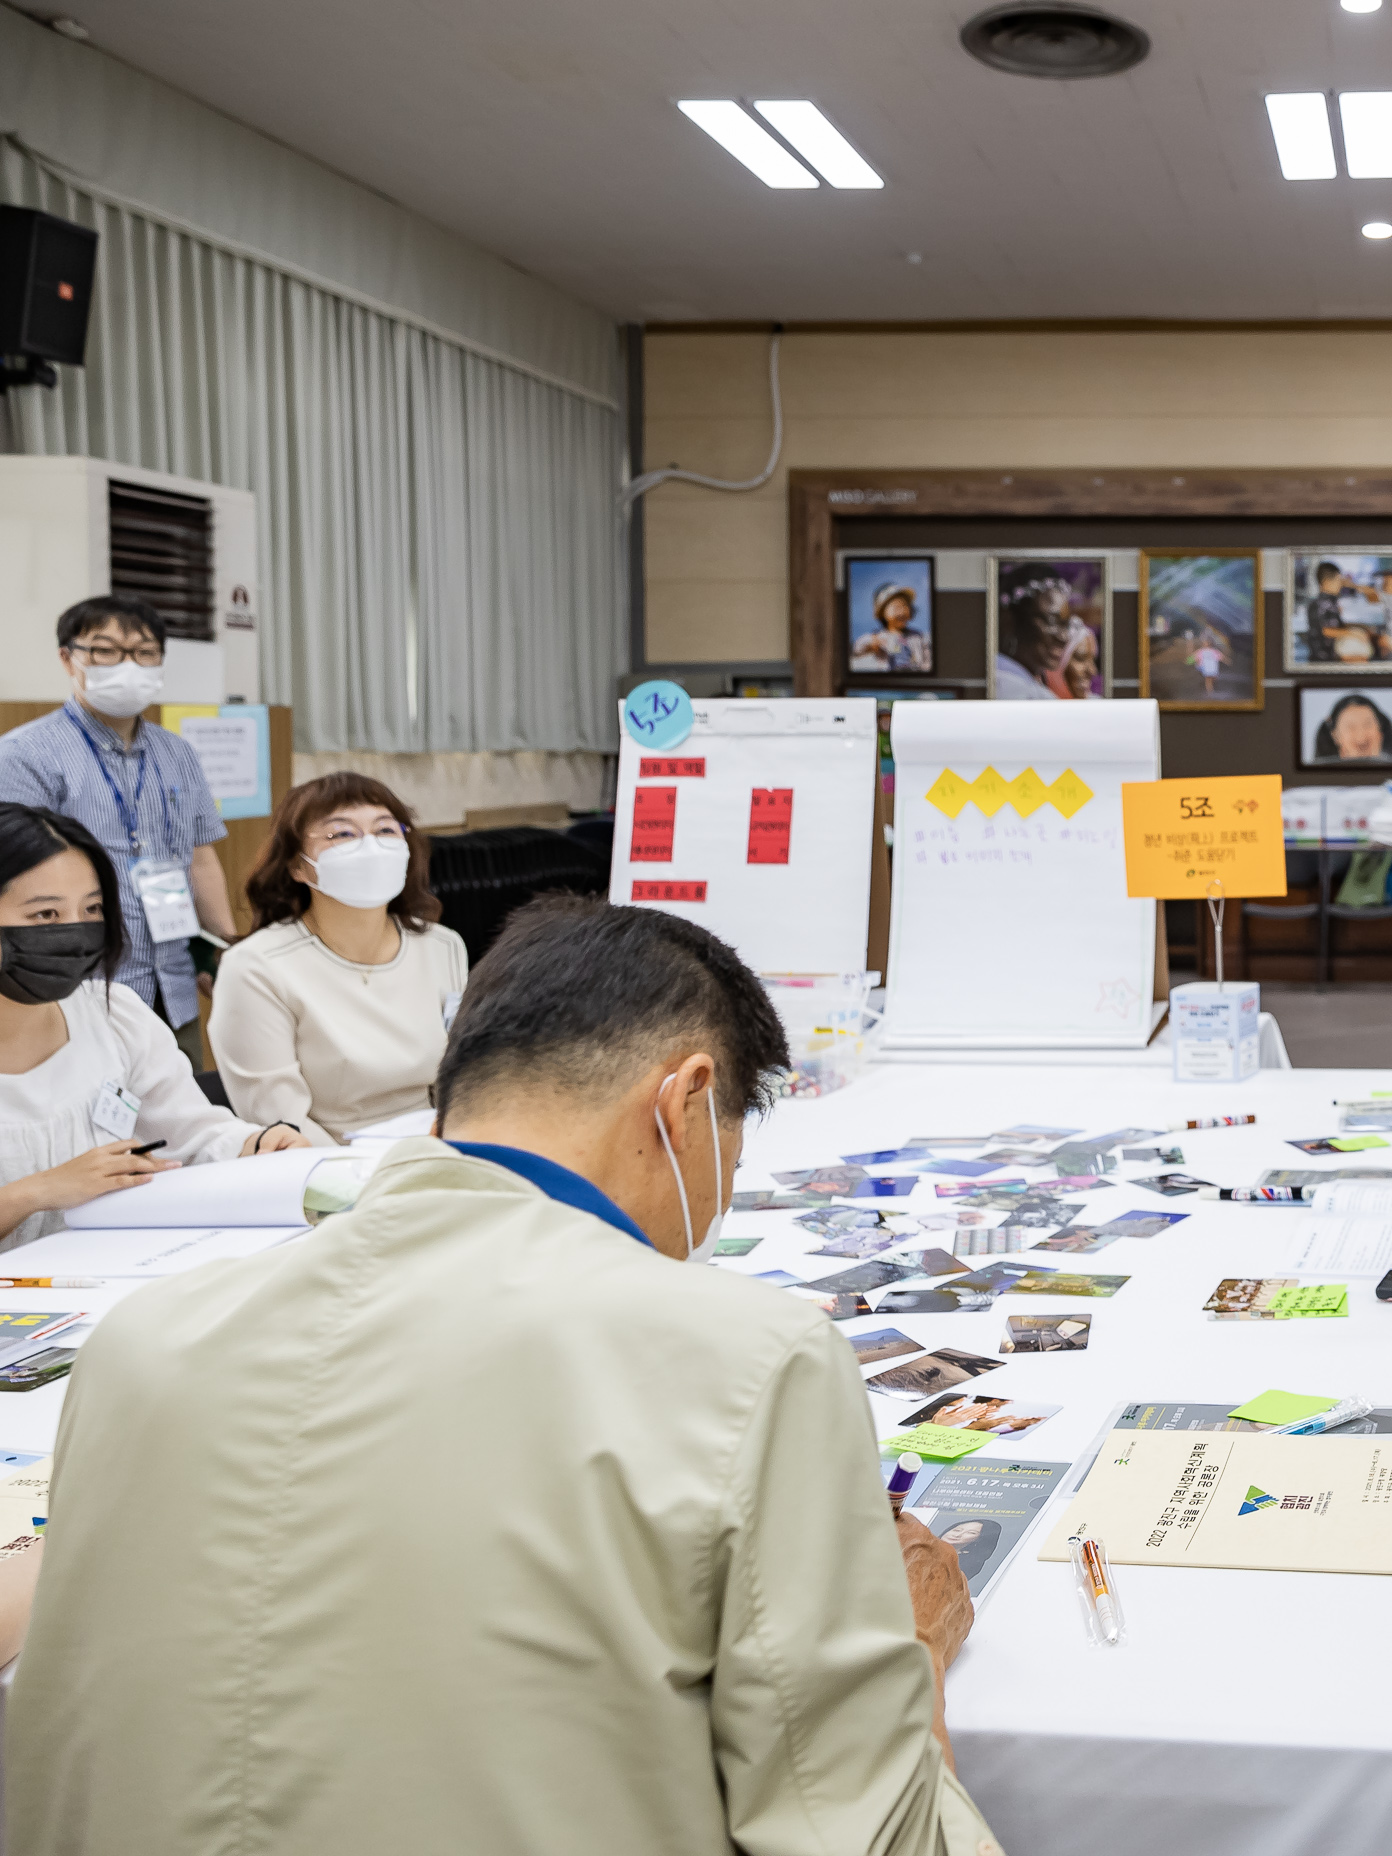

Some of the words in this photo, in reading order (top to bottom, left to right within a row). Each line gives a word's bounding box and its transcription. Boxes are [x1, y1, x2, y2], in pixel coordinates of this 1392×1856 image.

[628, 691, 679, 735] 5조
[1179, 797, 1215, 820] 5조
[8, 1479, 49, 1488] 2022
[1197, 1465, 1219, 1488] 공론장
[1146, 1529, 1168, 1548] 2022
[1157, 1507, 1180, 1527] 광진구
[1170, 1443, 1209, 1504] 지역사회혁신계획
[1188, 1491, 1208, 1506] 위한
[1279, 1495, 1299, 1510] 협치
[1295, 1495, 1314, 1510] 광진
[1177, 1509, 1200, 1529] 수립을
